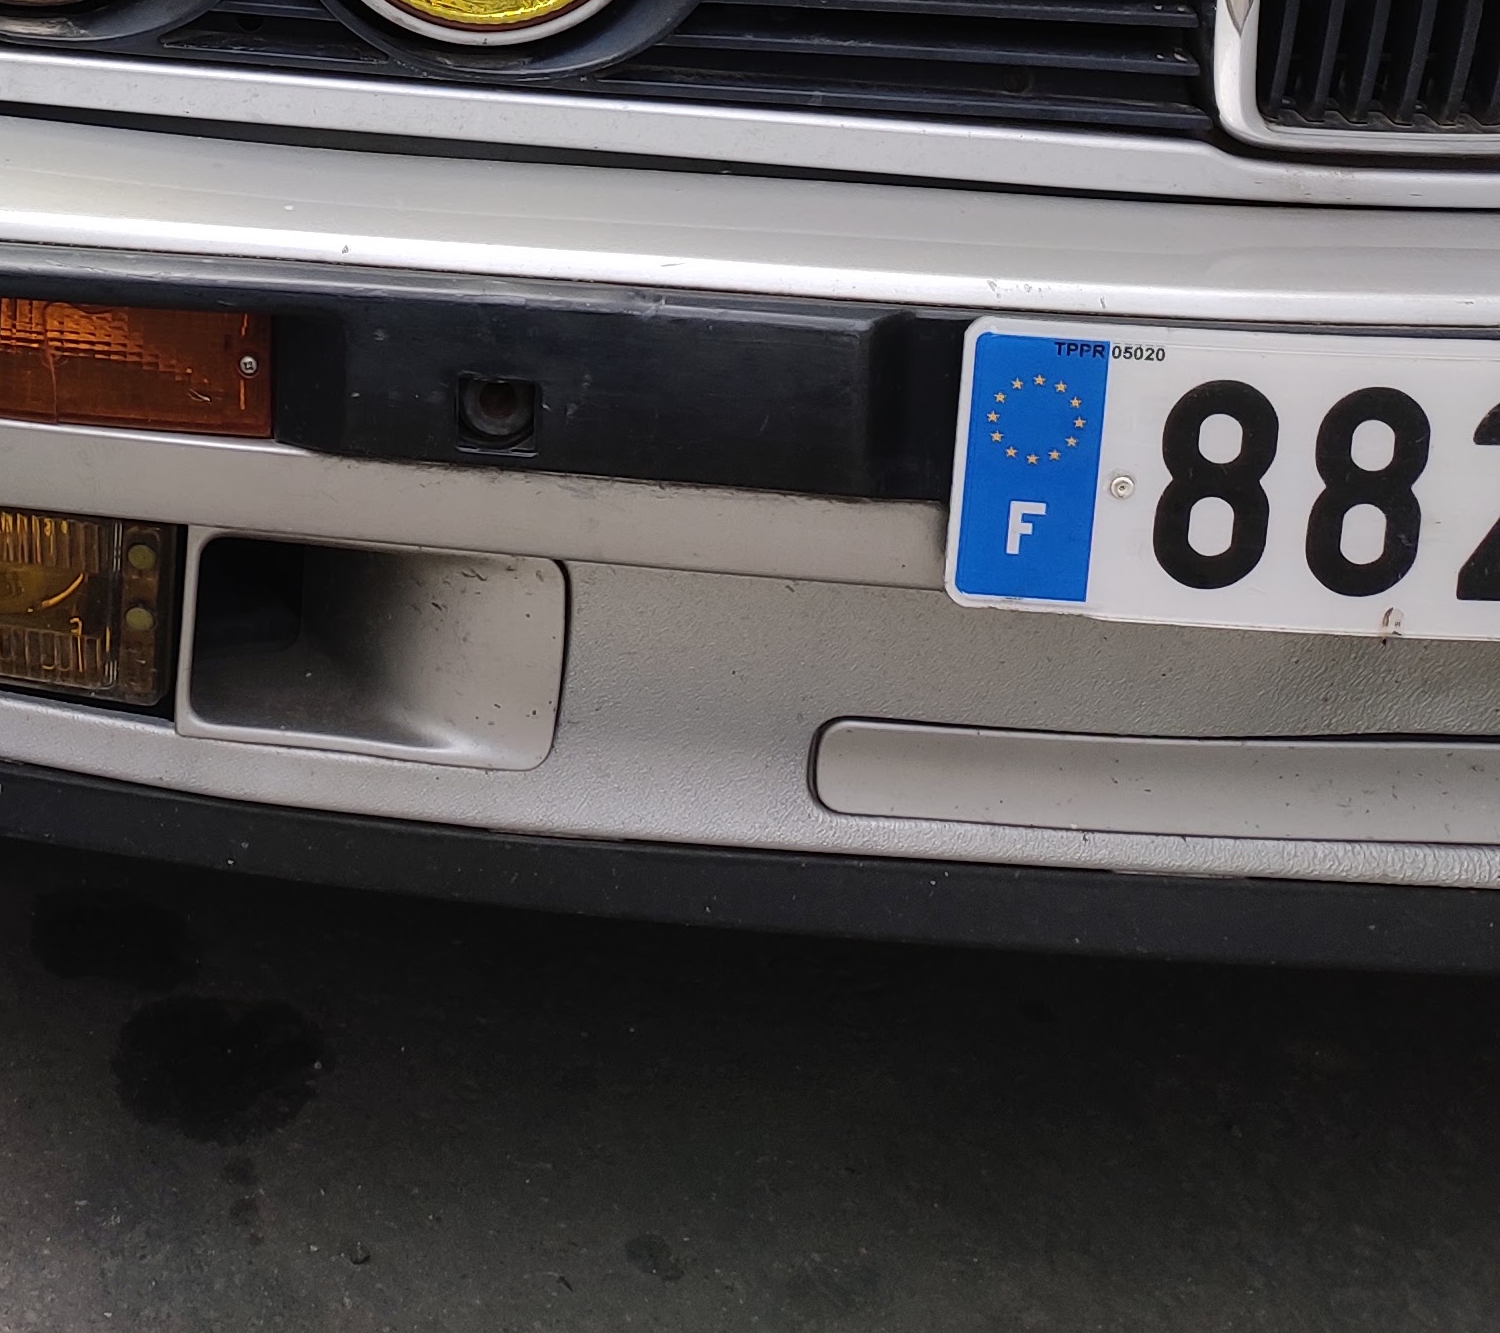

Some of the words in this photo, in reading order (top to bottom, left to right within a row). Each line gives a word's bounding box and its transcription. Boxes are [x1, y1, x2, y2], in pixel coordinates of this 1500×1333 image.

[1053, 341, 1106, 359] TPPR
[1111, 345, 1167, 362] 05020
[1005, 500, 1047, 555] F
